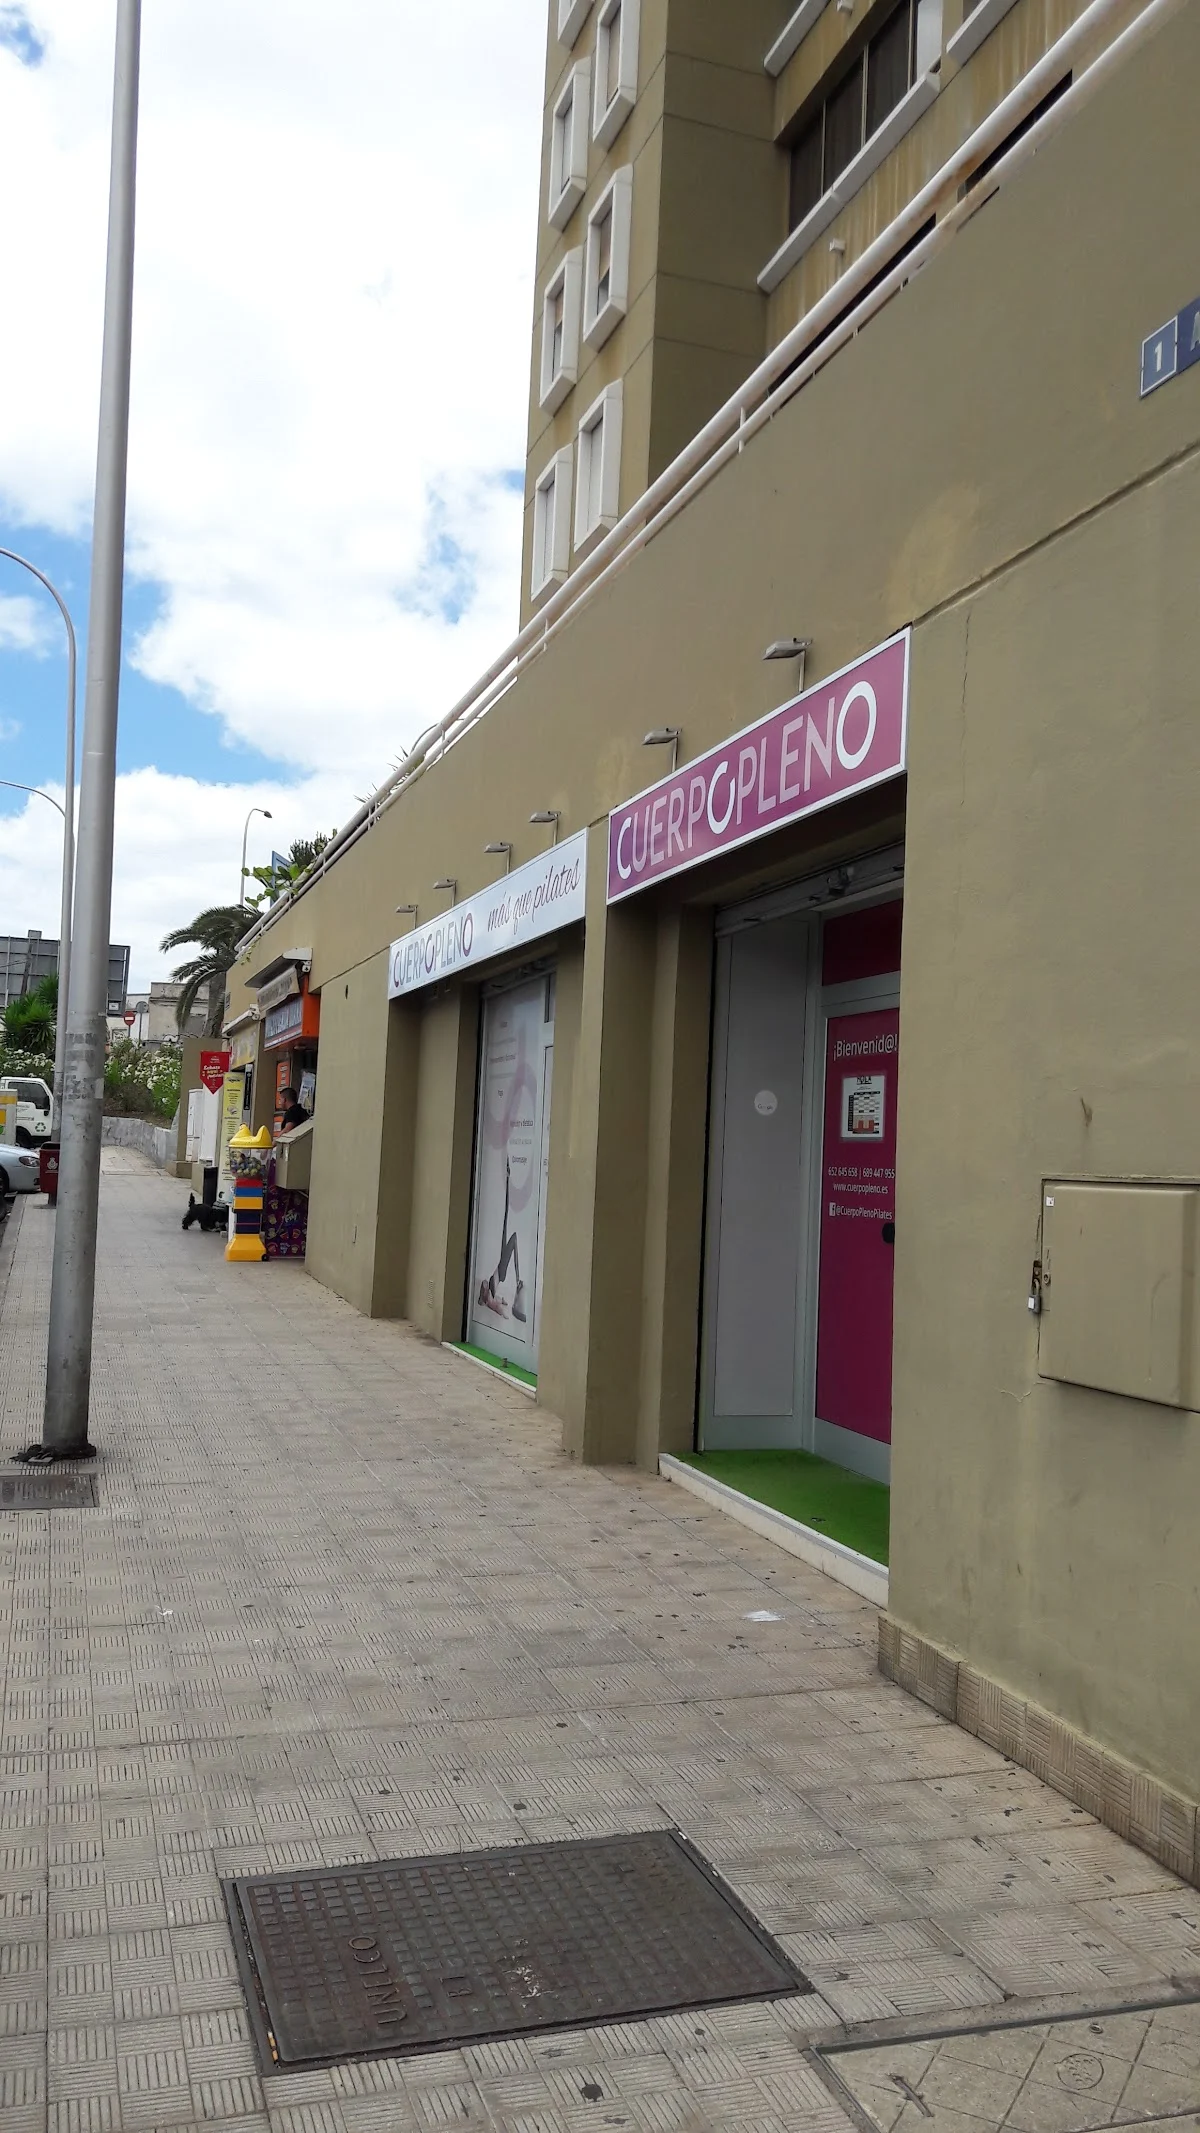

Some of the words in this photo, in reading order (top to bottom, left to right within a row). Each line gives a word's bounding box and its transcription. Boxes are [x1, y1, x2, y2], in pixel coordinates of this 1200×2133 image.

[616, 680, 877, 880] CUERPOPLENO
[393, 912, 474, 988] CUERPOPLENO
[487, 891, 512, 932] más
[511, 888, 533, 935] que
[532, 858, 581, 922] pilates
[833, 1033, 898, 1061] ¡Bienvenid@!
[828, 1166, 838, 1176] 652
[838, 1167, 847, 1177] 645
[848, 1167, 858, 1177] 658
[862, 1168, 873, 1178] 689
[873, 1168, 884, 1178] 447
[833, 1183, 889, 1195] www.cuerpopleno.es
[836, 1205, 893, 1220] @CuerpoPlenoPilates
[348, 1935, 408, 2025] UNELCO
